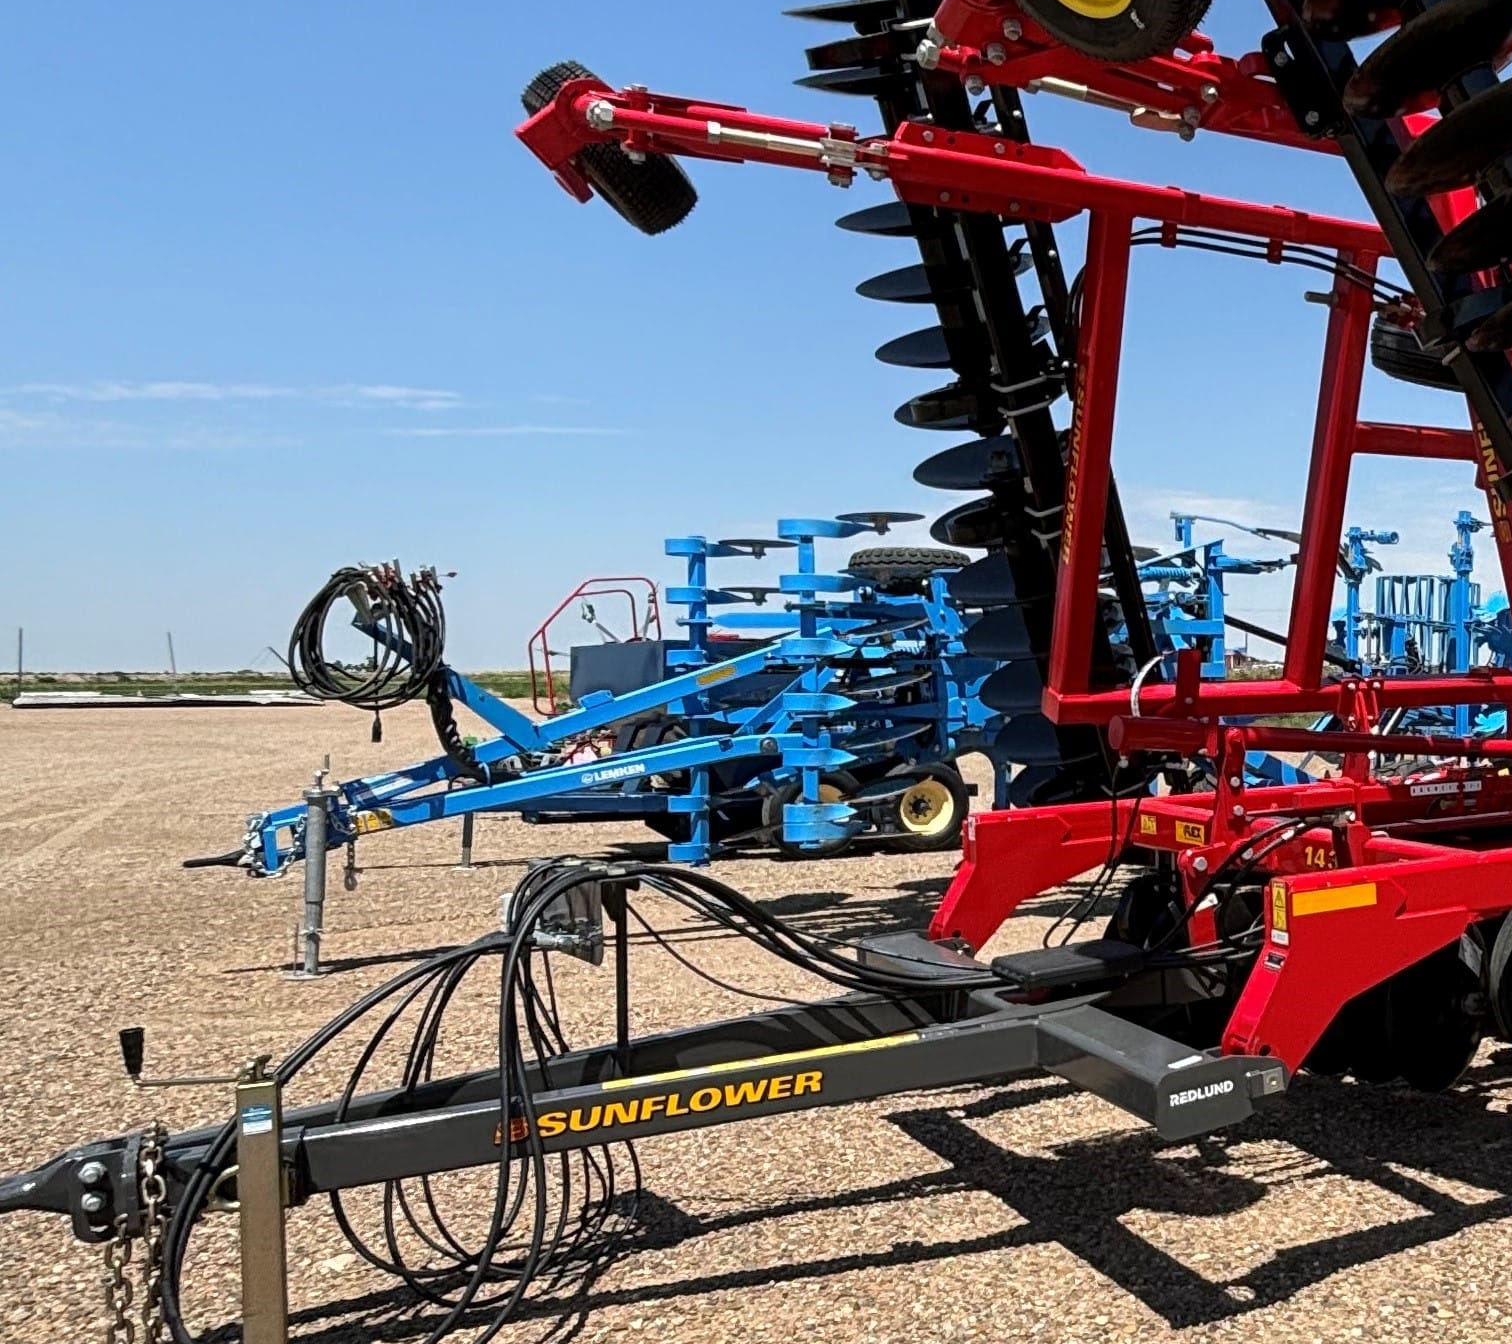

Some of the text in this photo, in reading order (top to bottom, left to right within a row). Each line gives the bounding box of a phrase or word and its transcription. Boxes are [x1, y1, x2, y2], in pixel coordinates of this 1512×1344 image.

[1063, 389, 1086, 565] SUNFLOWER
[594, 763, 646, 781] LEMKEN
[537, 1070, 823, 1137] SUNFLOWER
[1169, 1080, 1234, 1107] REDLUND
